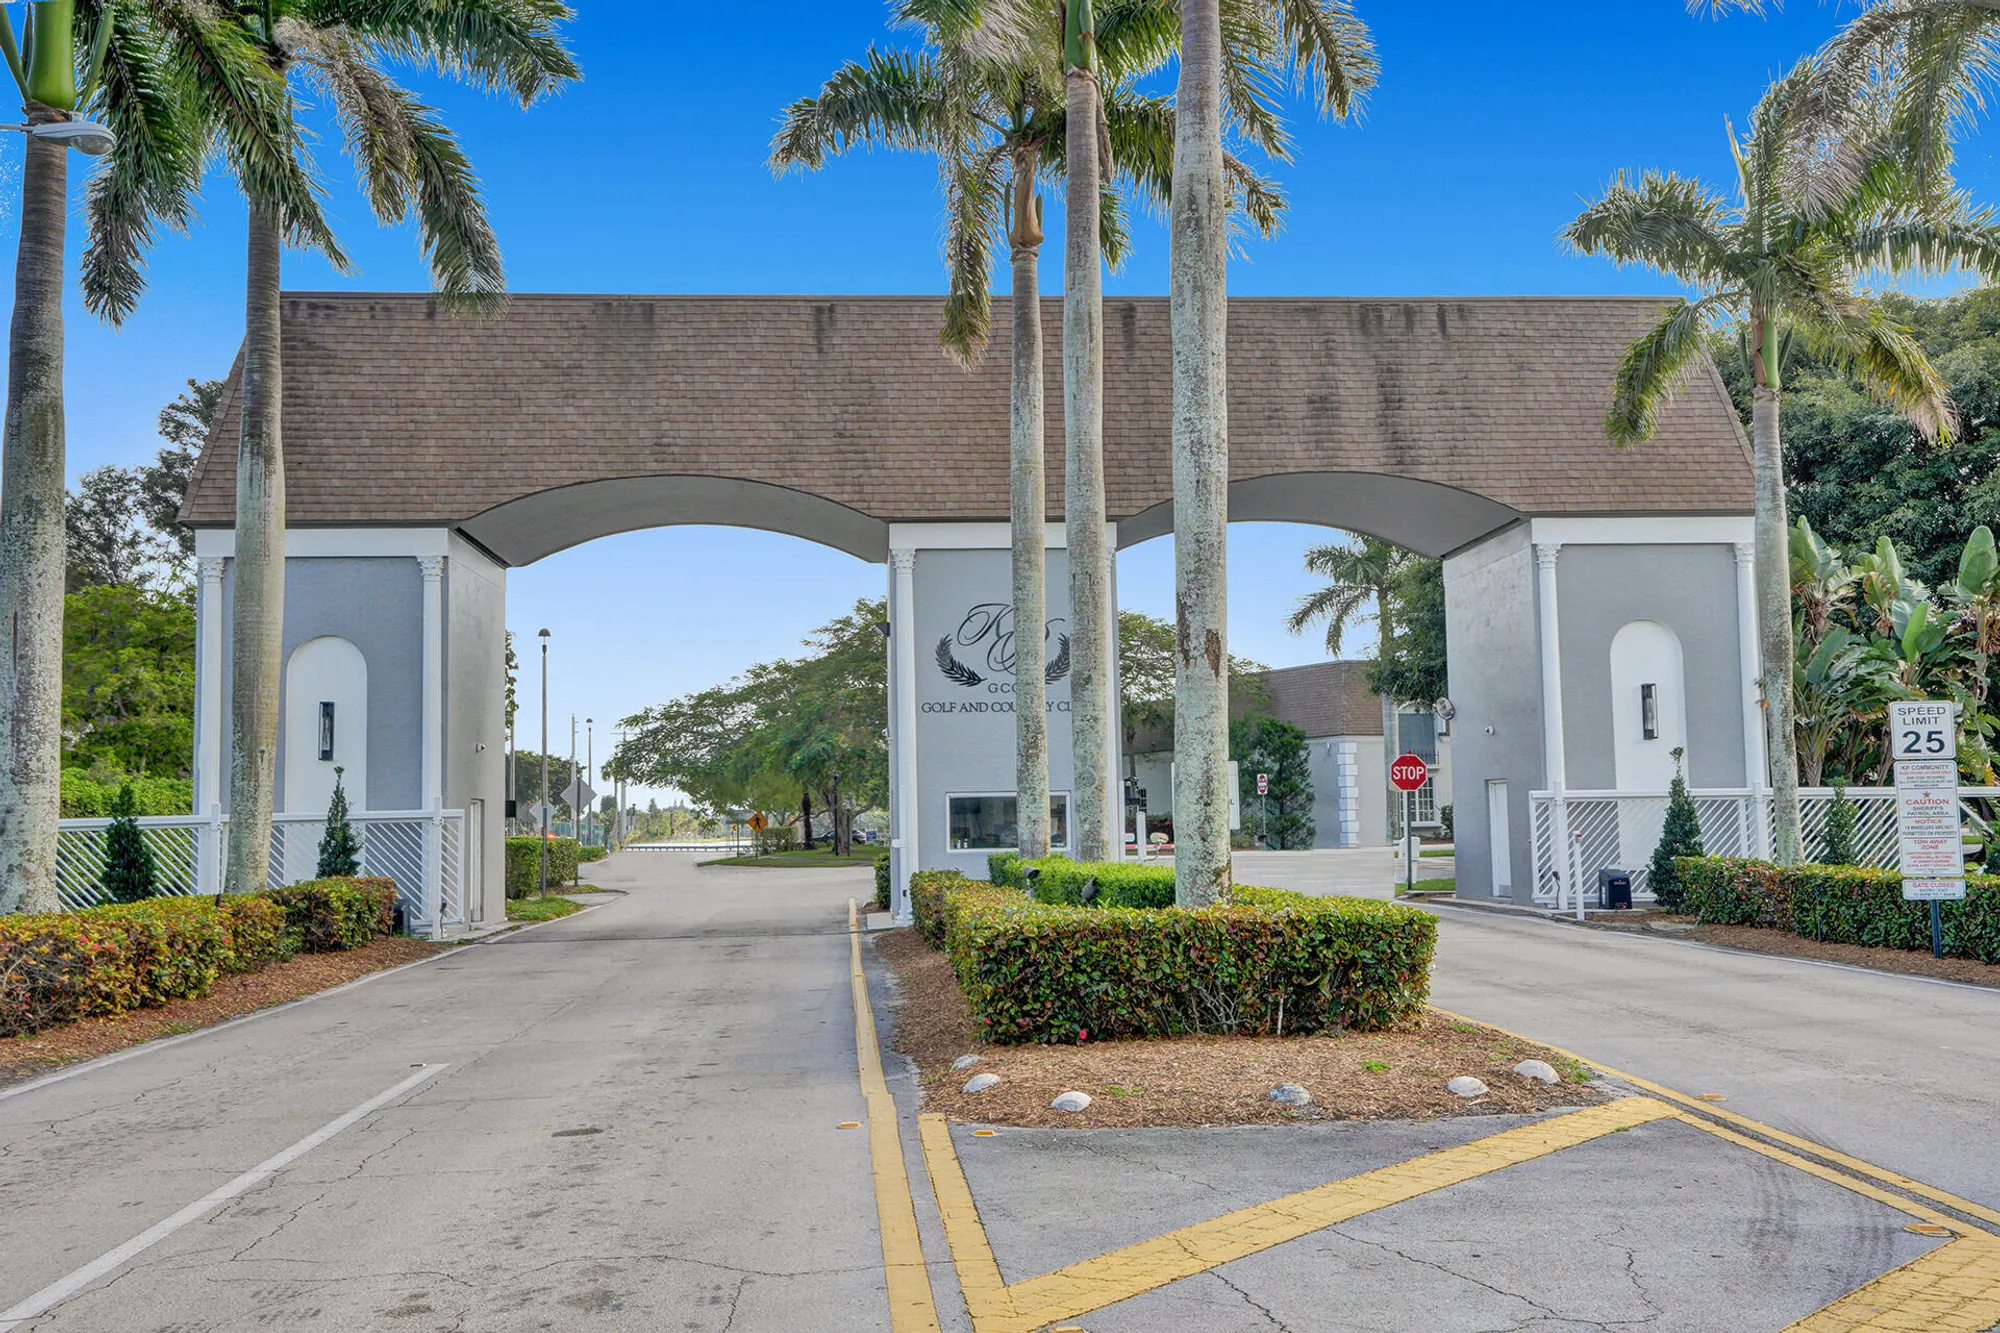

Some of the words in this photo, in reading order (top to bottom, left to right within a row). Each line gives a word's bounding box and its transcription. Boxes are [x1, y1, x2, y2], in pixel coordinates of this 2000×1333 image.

[921, 702, 957, 713] GOLF
[959, 702, 989, 713] AND
[1897, 706, 1946, 716] SPEED
[1903, 716, 1940, 726] LIMIT
[1902, 730, 1945, 754] 25
[1392, 766, 1425, 780] STOP
[1905, 798, 1950, 806] CAUTION
